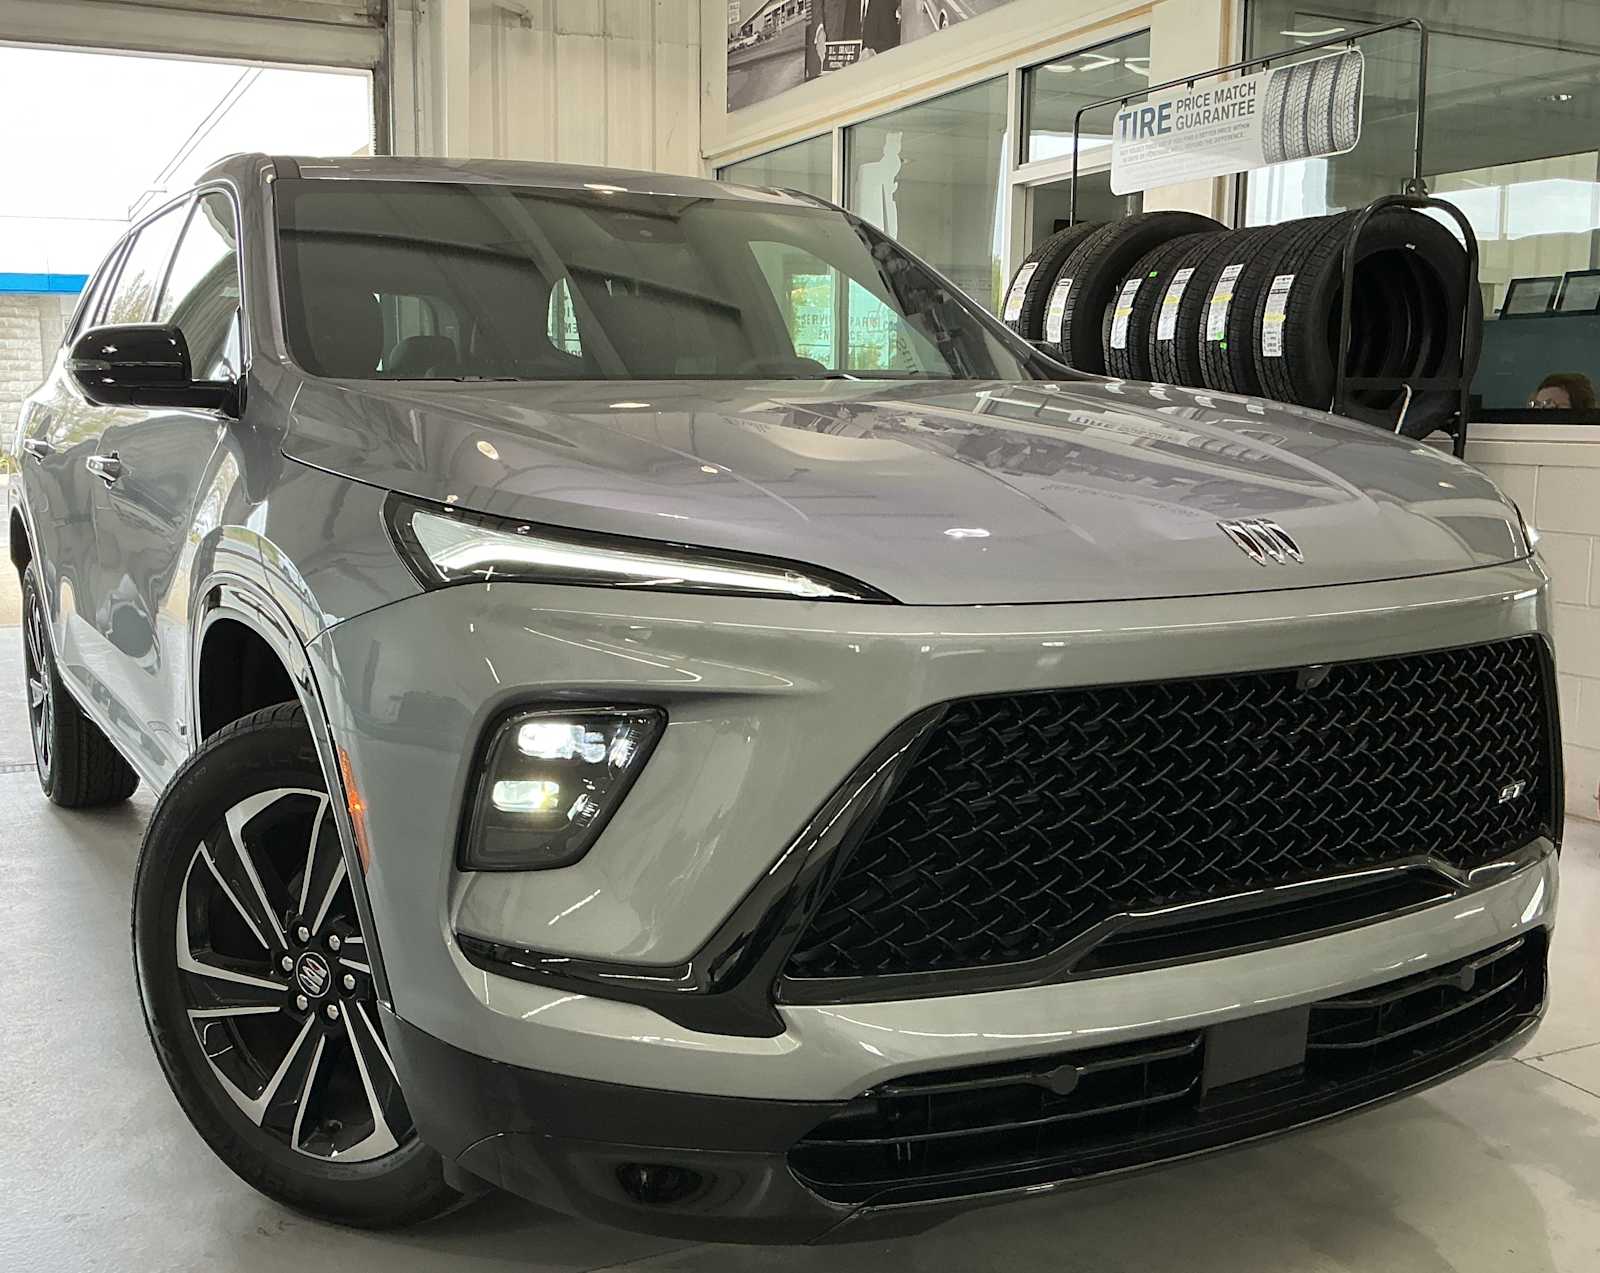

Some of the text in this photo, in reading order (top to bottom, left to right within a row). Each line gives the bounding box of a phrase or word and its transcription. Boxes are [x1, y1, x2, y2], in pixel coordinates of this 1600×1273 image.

[1176, 81, 1256, 113] PRICE MATCH
[1119, 102, 1172, 143] TIRE
[1176, 99, 1256, 130] GUARANTEE
